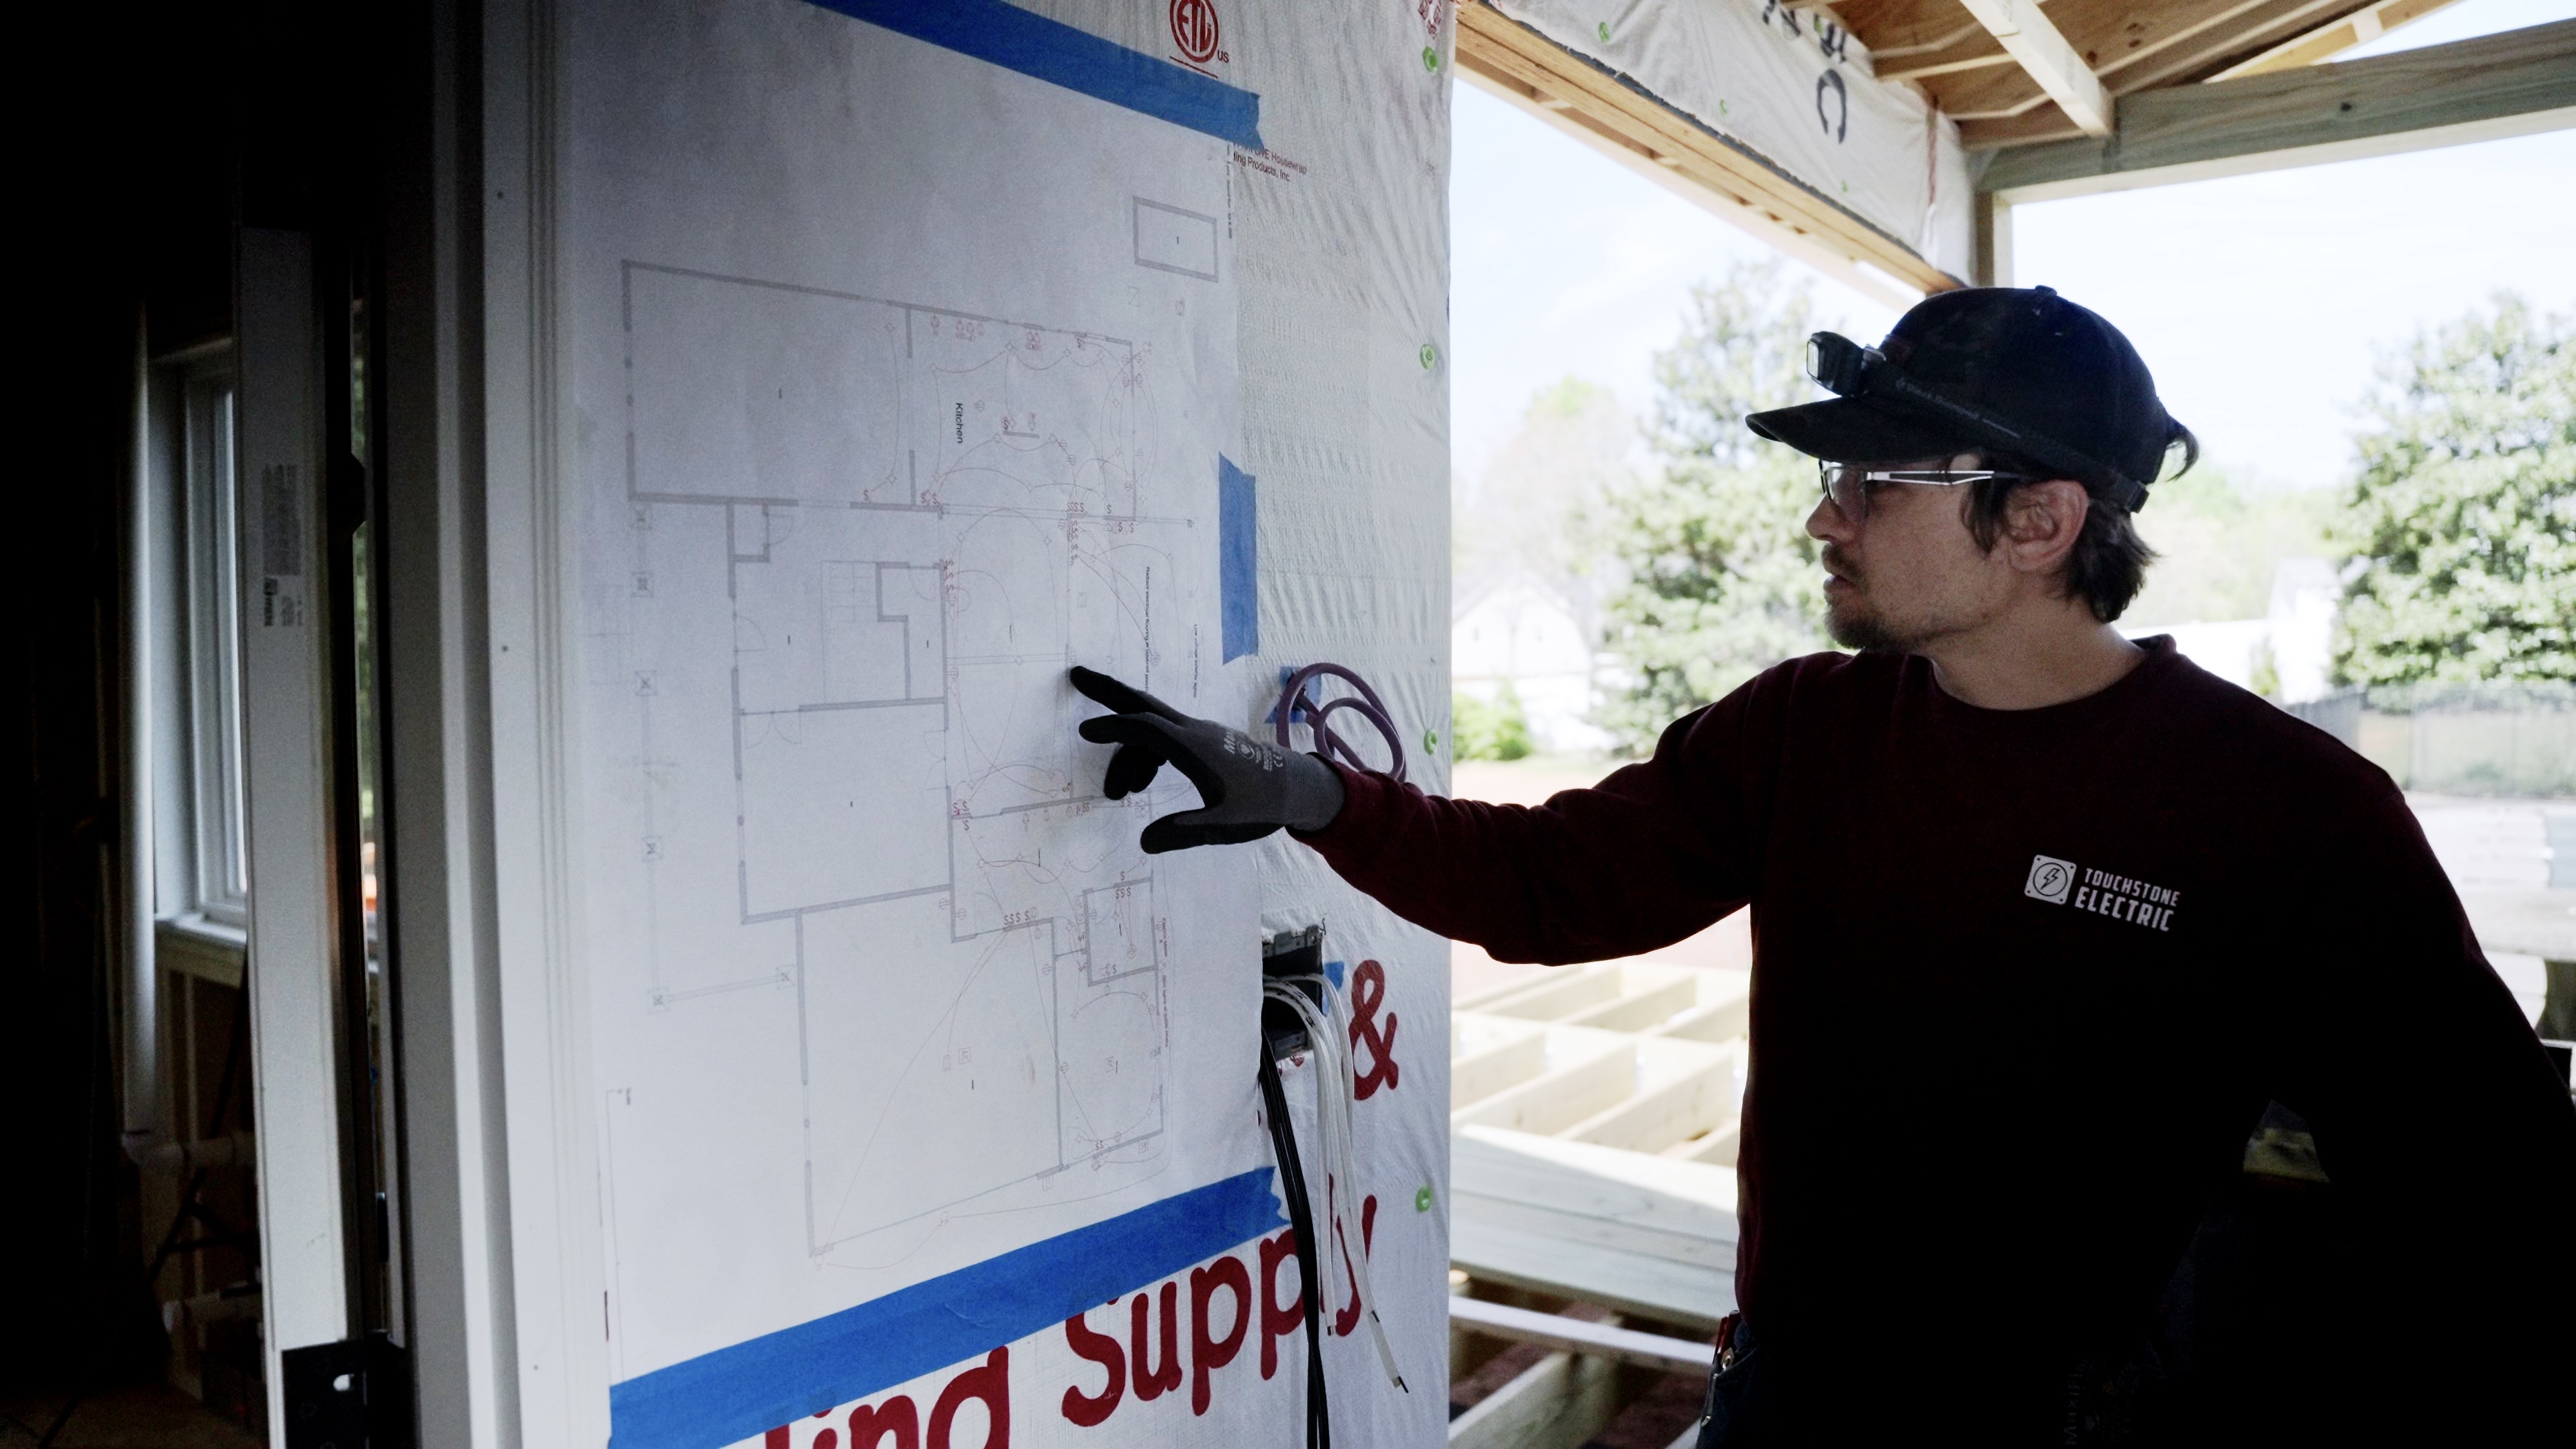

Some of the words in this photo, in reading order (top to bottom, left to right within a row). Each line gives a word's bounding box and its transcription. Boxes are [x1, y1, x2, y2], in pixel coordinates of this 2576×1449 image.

[1247, 156, 1278, 178] Products,
[1279, 168, 1291, 182] Inc.
[1271, 150, 1307, 174] Housewrap
[955, 402, 963, 443] Kitchen
[2084, 867, 2181, 907] TOUCHSTONE
[2074, 886, 2174, 932] ELECTRIC
[1344, 959, 1399, 1101] &
